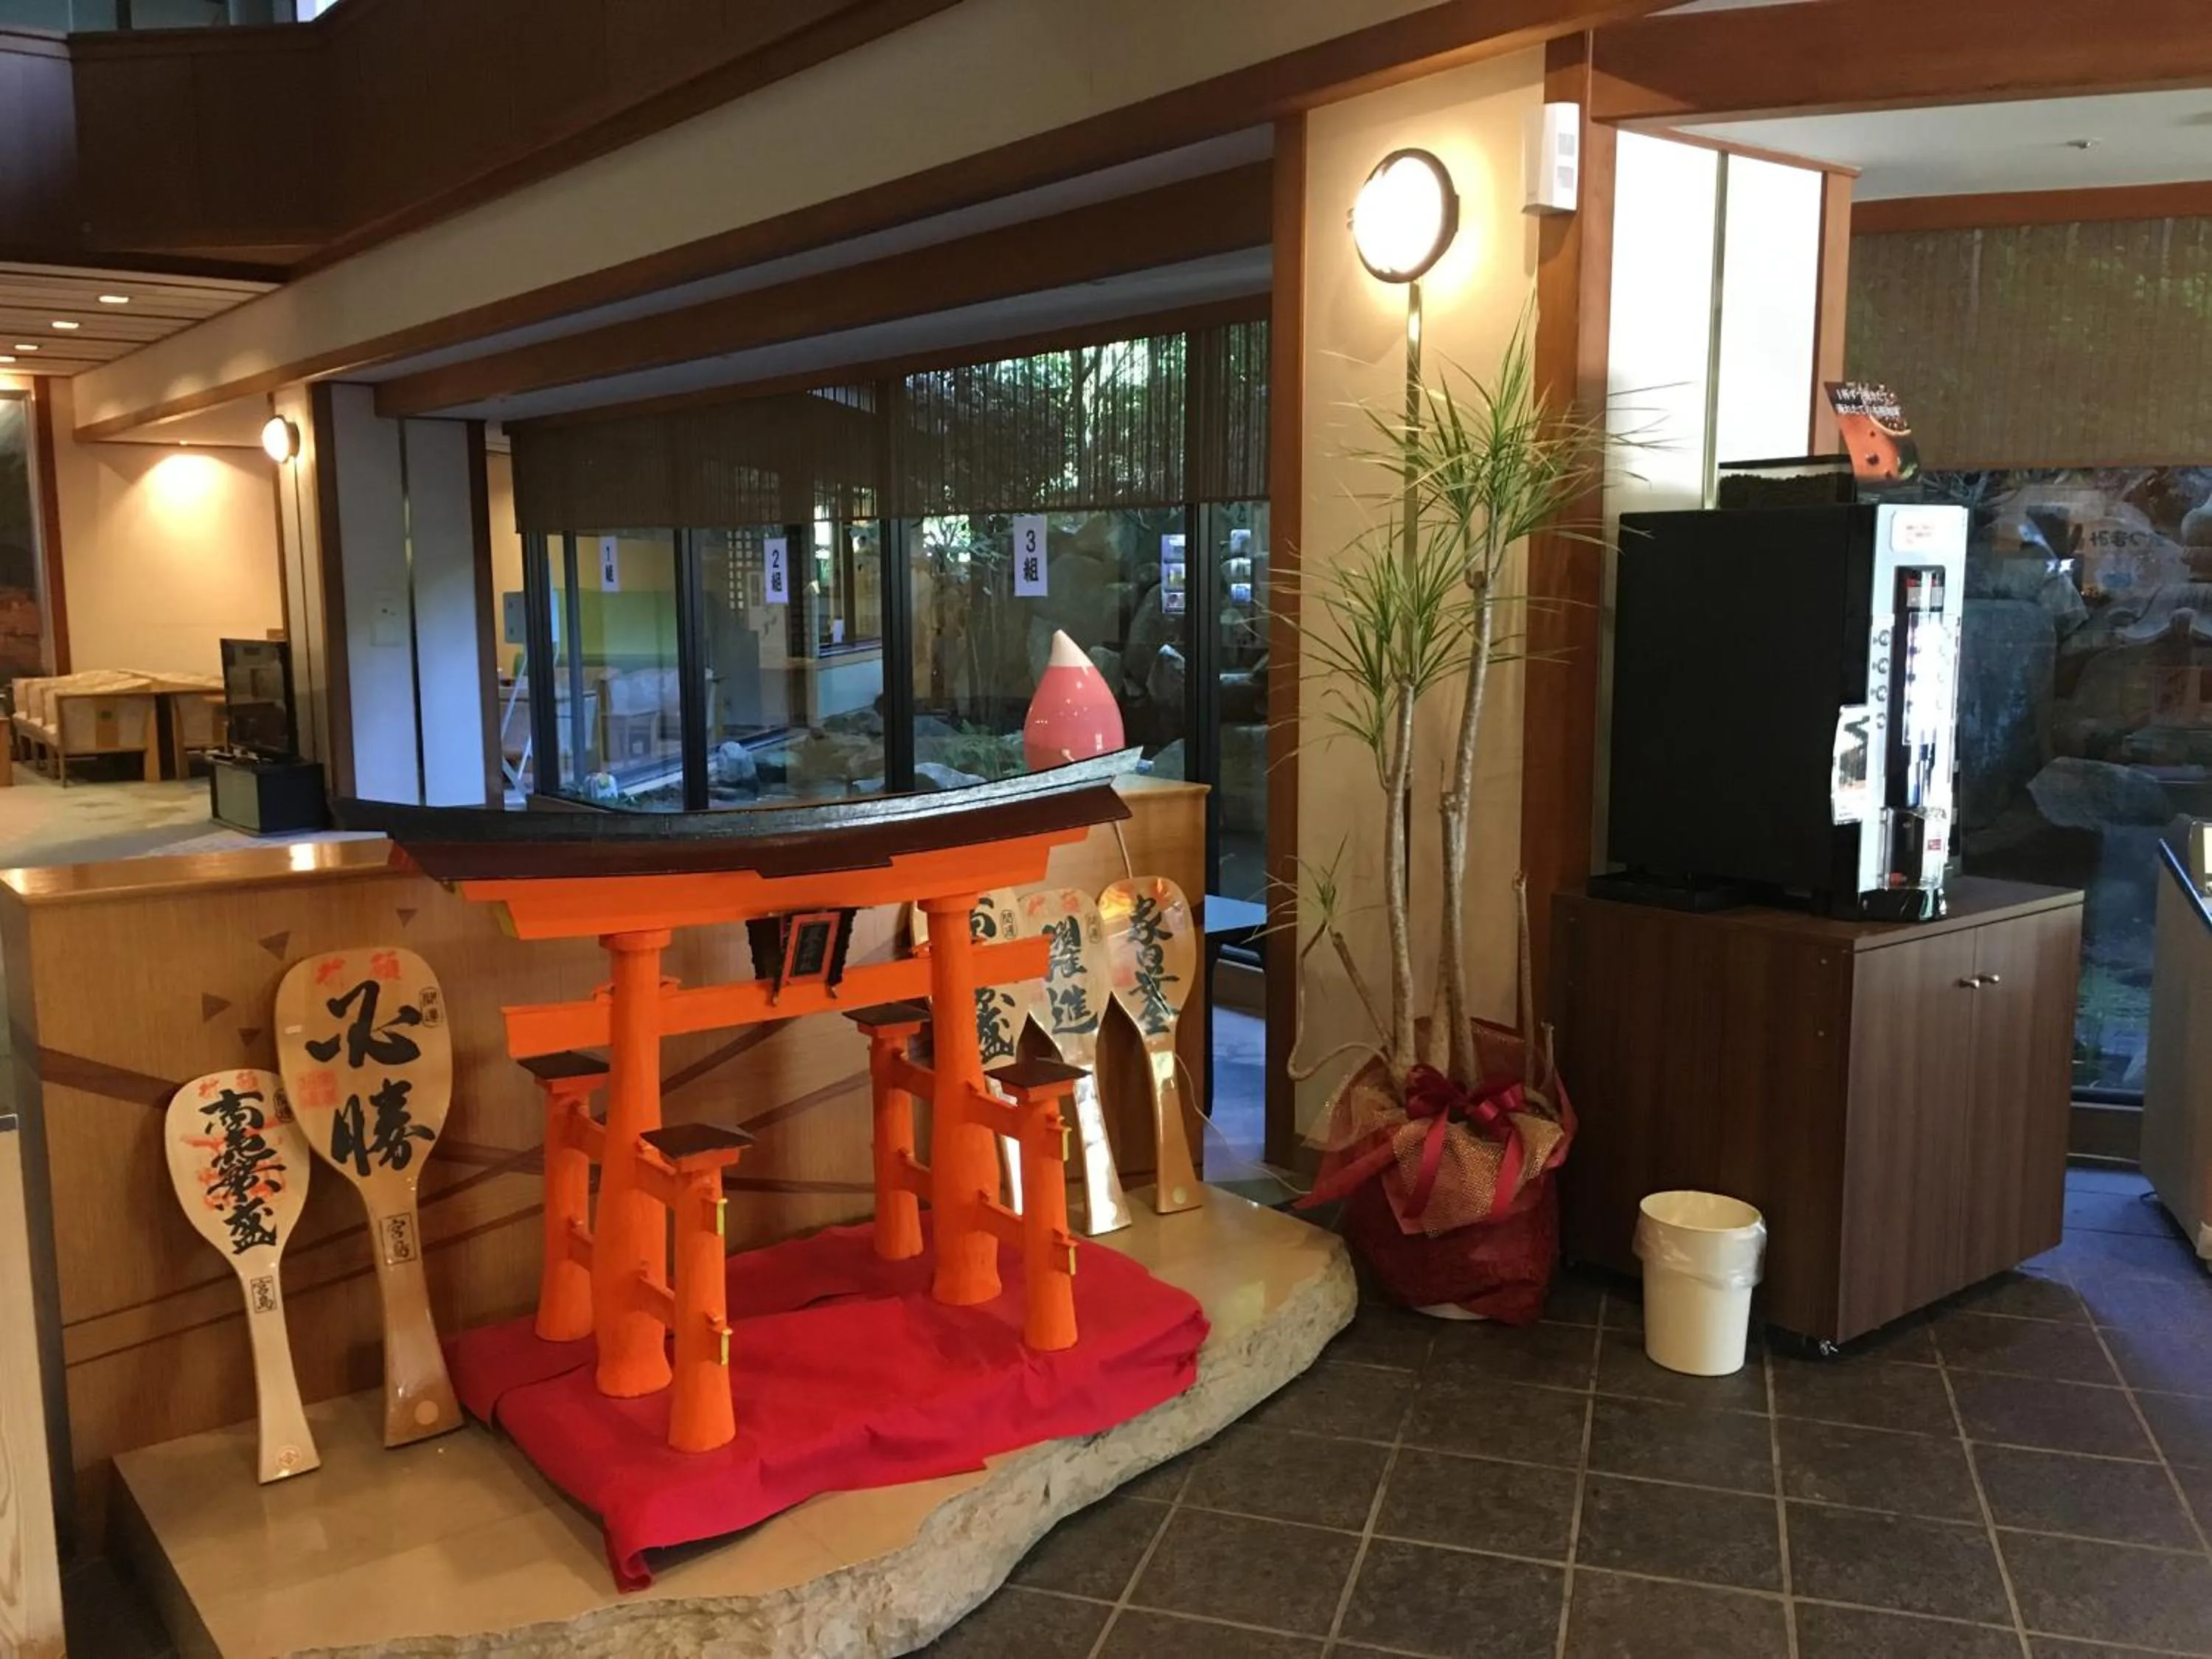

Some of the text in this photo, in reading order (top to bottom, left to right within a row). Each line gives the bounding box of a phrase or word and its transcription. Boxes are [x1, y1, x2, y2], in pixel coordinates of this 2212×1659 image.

[771, 549, 783, 592] 2組
[1023, 529, 1039, 582] 3組
[304, 979, 437, 1178] 必勝
